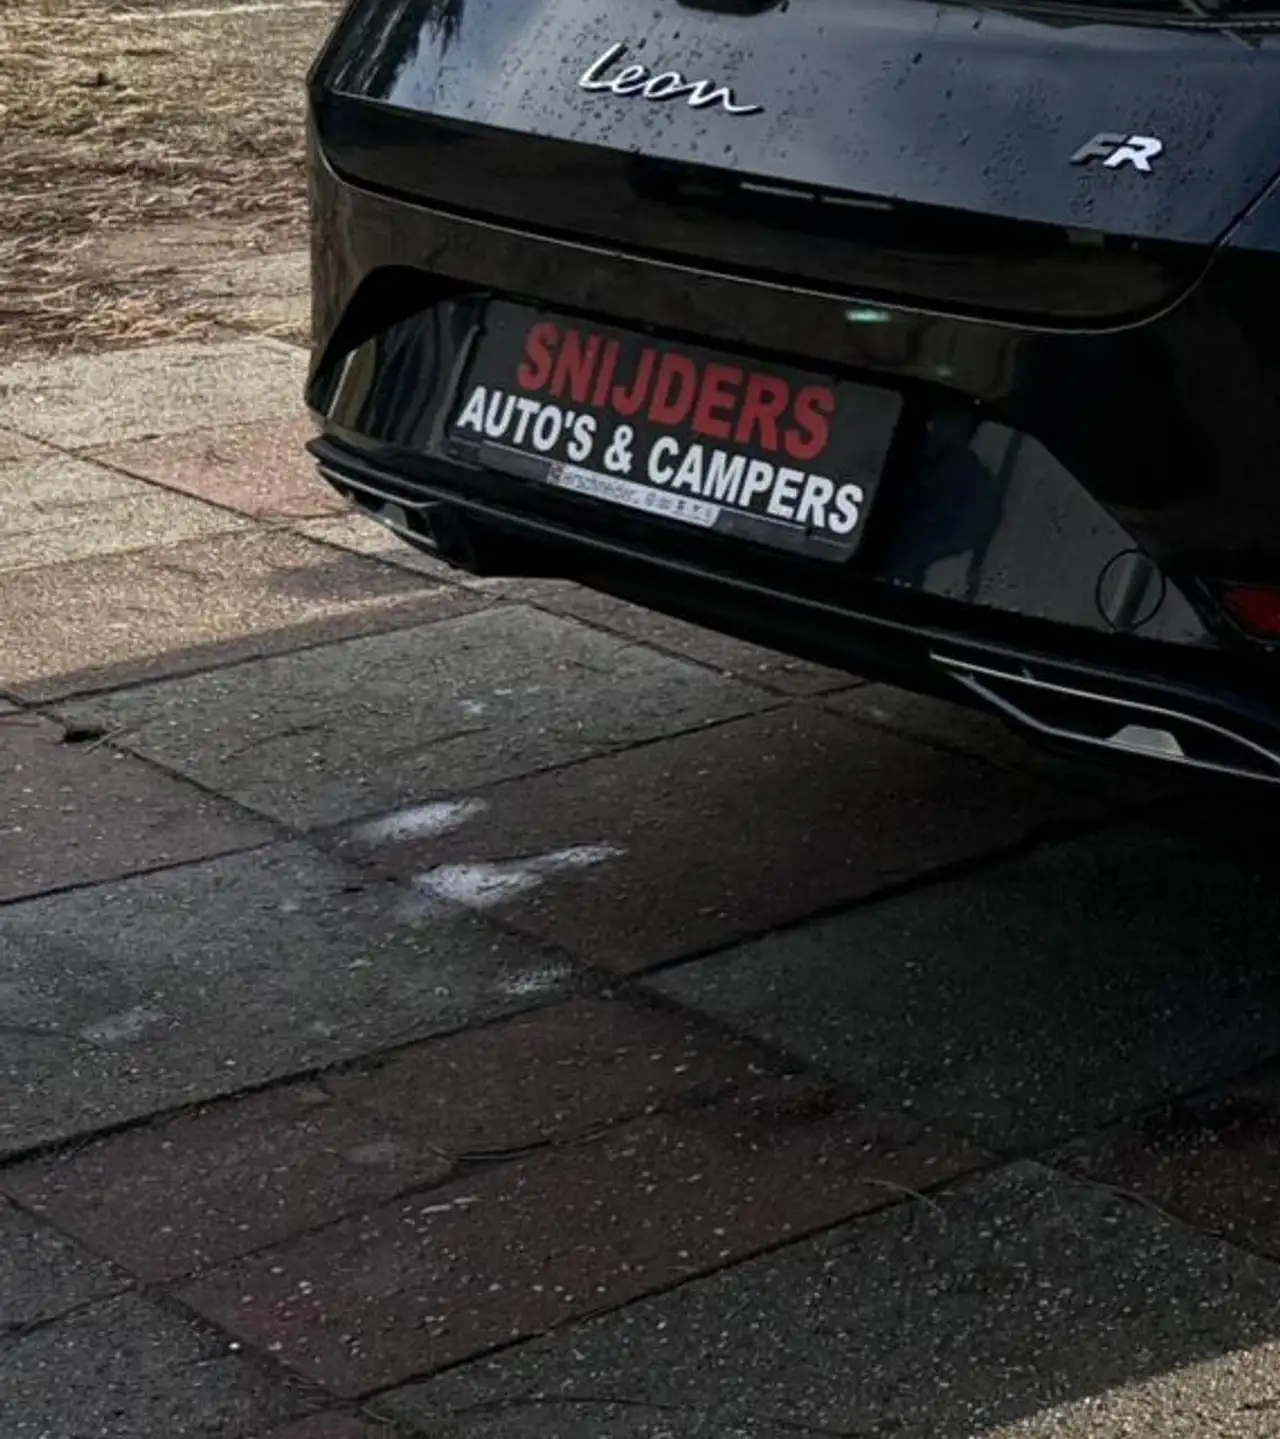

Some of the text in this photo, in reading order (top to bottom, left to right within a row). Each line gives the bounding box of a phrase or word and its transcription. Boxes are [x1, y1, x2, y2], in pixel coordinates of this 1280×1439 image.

[578, 42, 762, 113] Leon
[1071, 132, 1163, 172] FR
[518, 322, 834, 461] SNIJDERS
[456, 386, 597, 462] AUTO'S
[604, 424, 634, 475] &
[647, 436, 863, 535] CAMPERS
